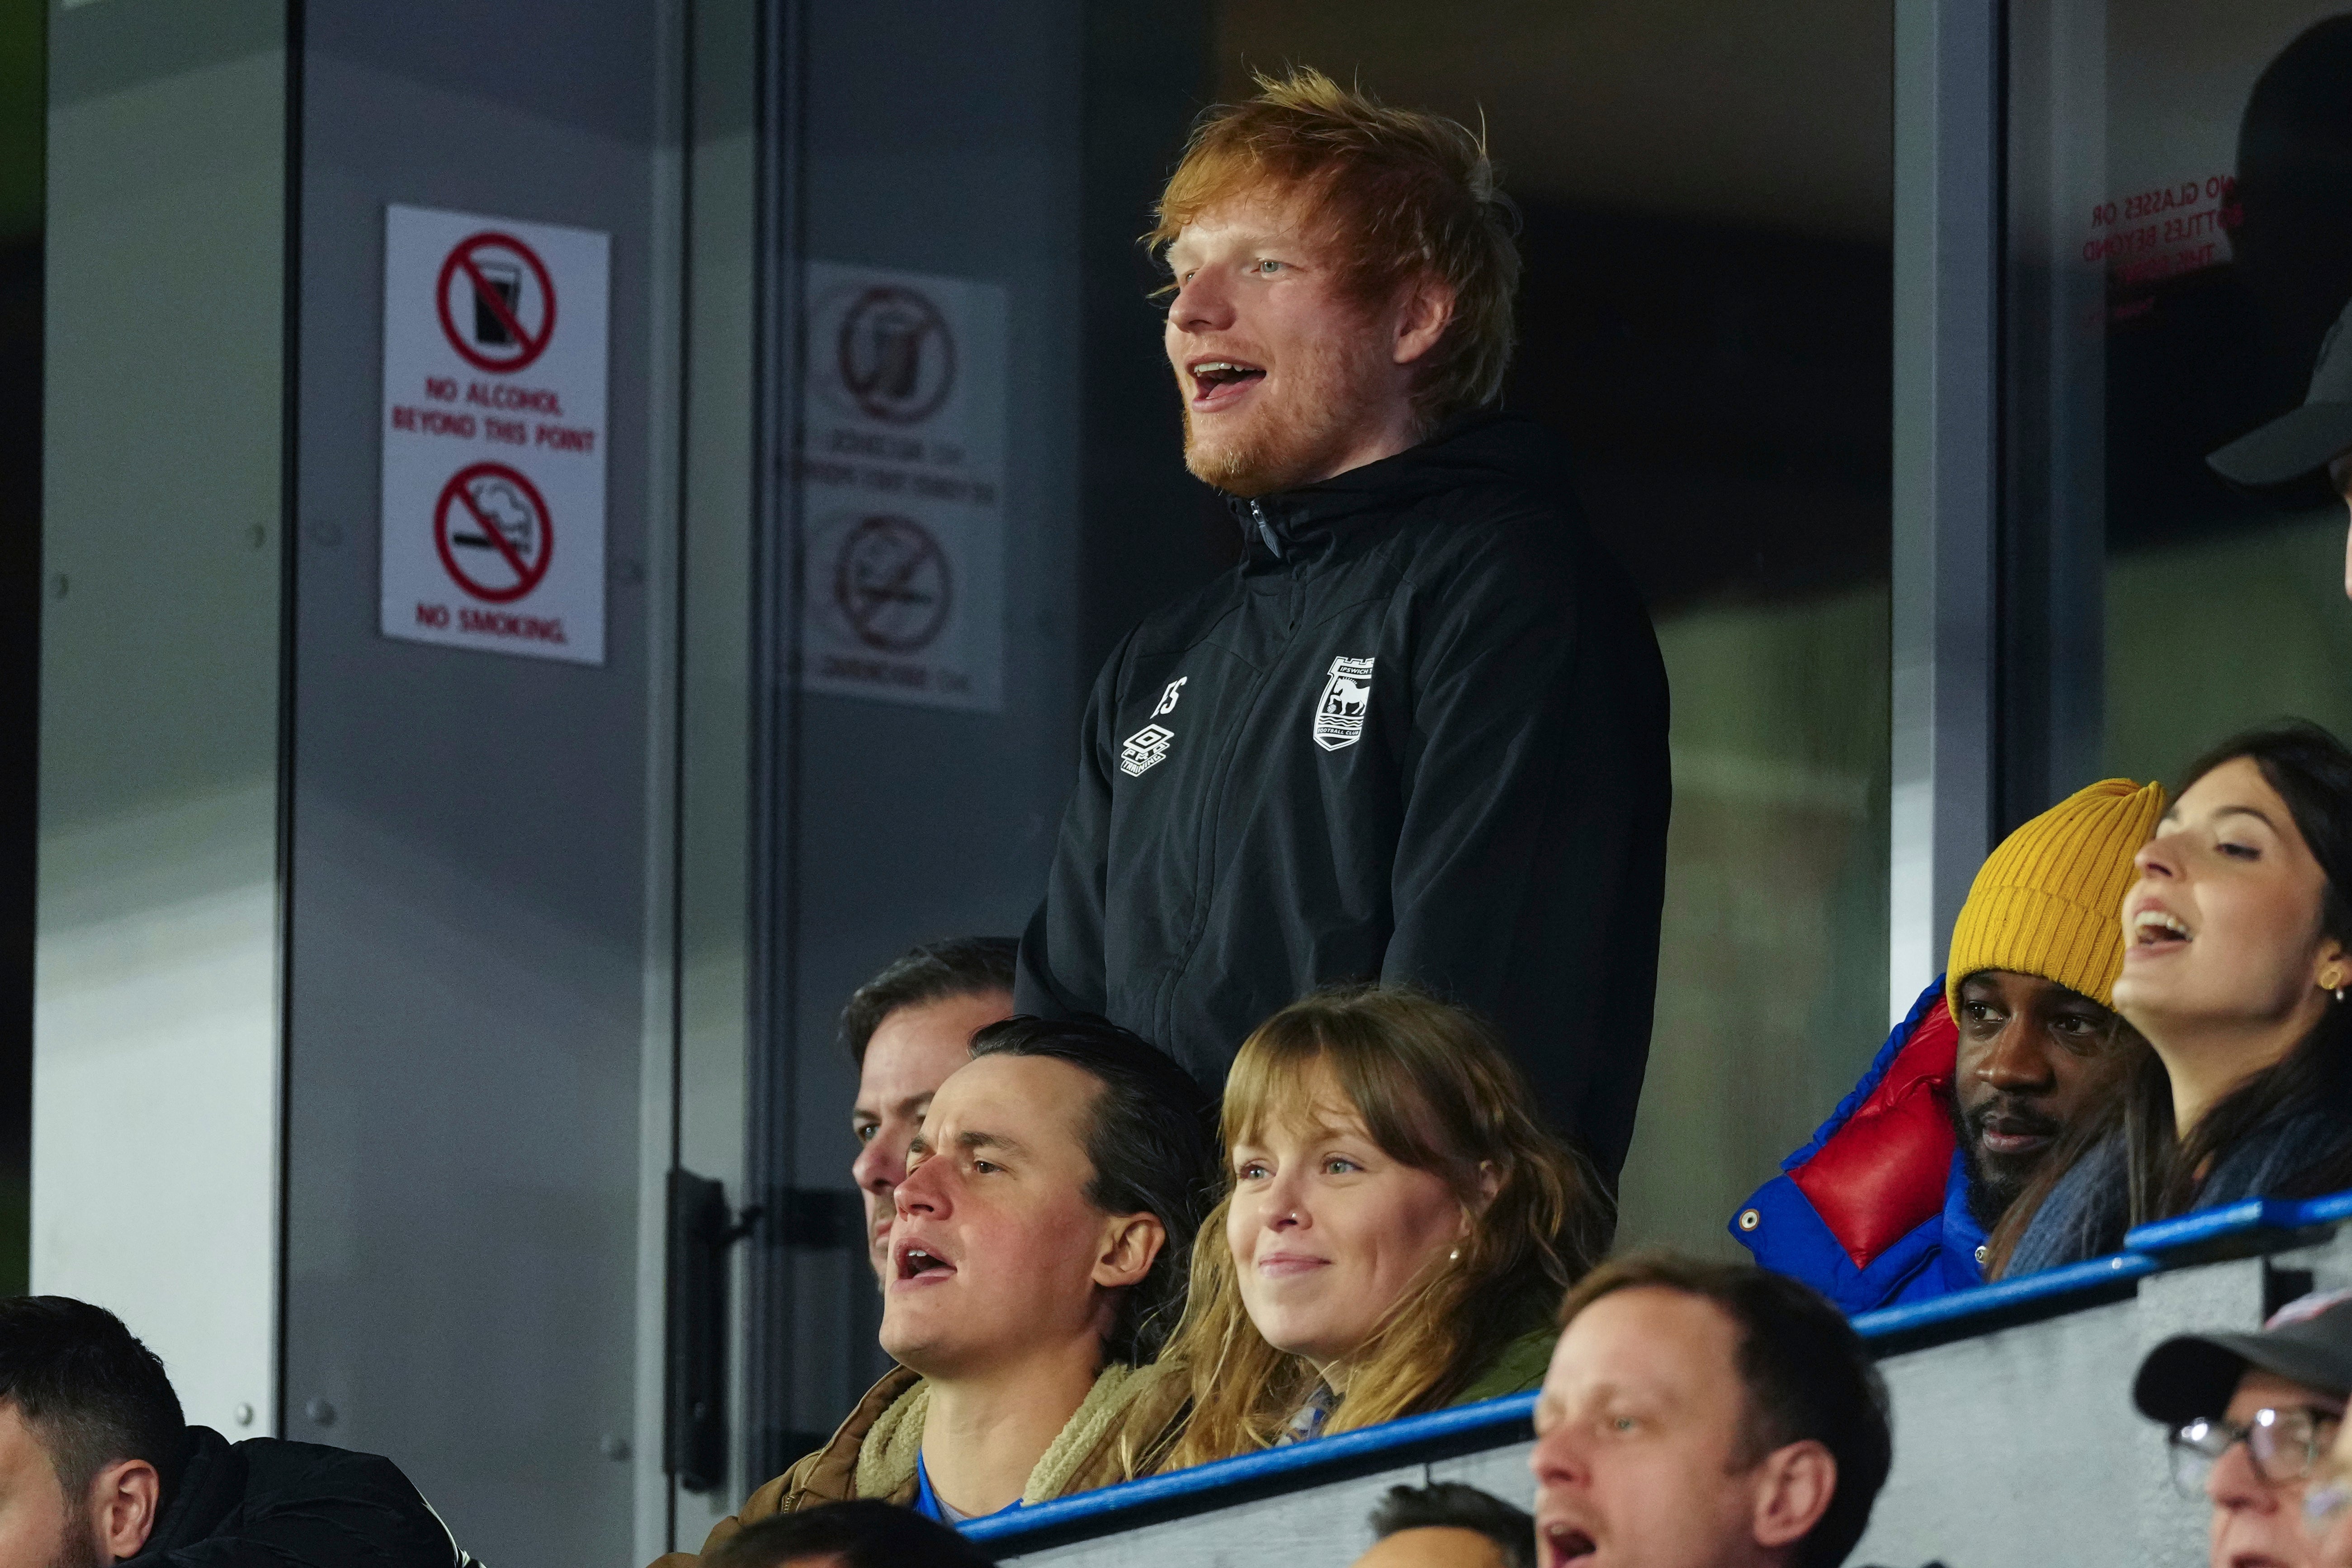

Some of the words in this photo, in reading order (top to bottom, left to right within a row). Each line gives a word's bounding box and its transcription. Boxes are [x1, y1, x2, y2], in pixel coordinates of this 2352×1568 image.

[425, 376, 458, 402] NO
[466, 381, 562, 416] ALCOHOL
[392, 405, 477, 440] BEYOND
[485, 416, 527, 446] THIS
[535, 424, 595, 453] POINT
[416, 602, 451, 628] NO
[458, 608, 566, 644] SMOKING
[1122, 754, 1162, 774] TRAINING
[1123, 743, 1167, 761] PRO
